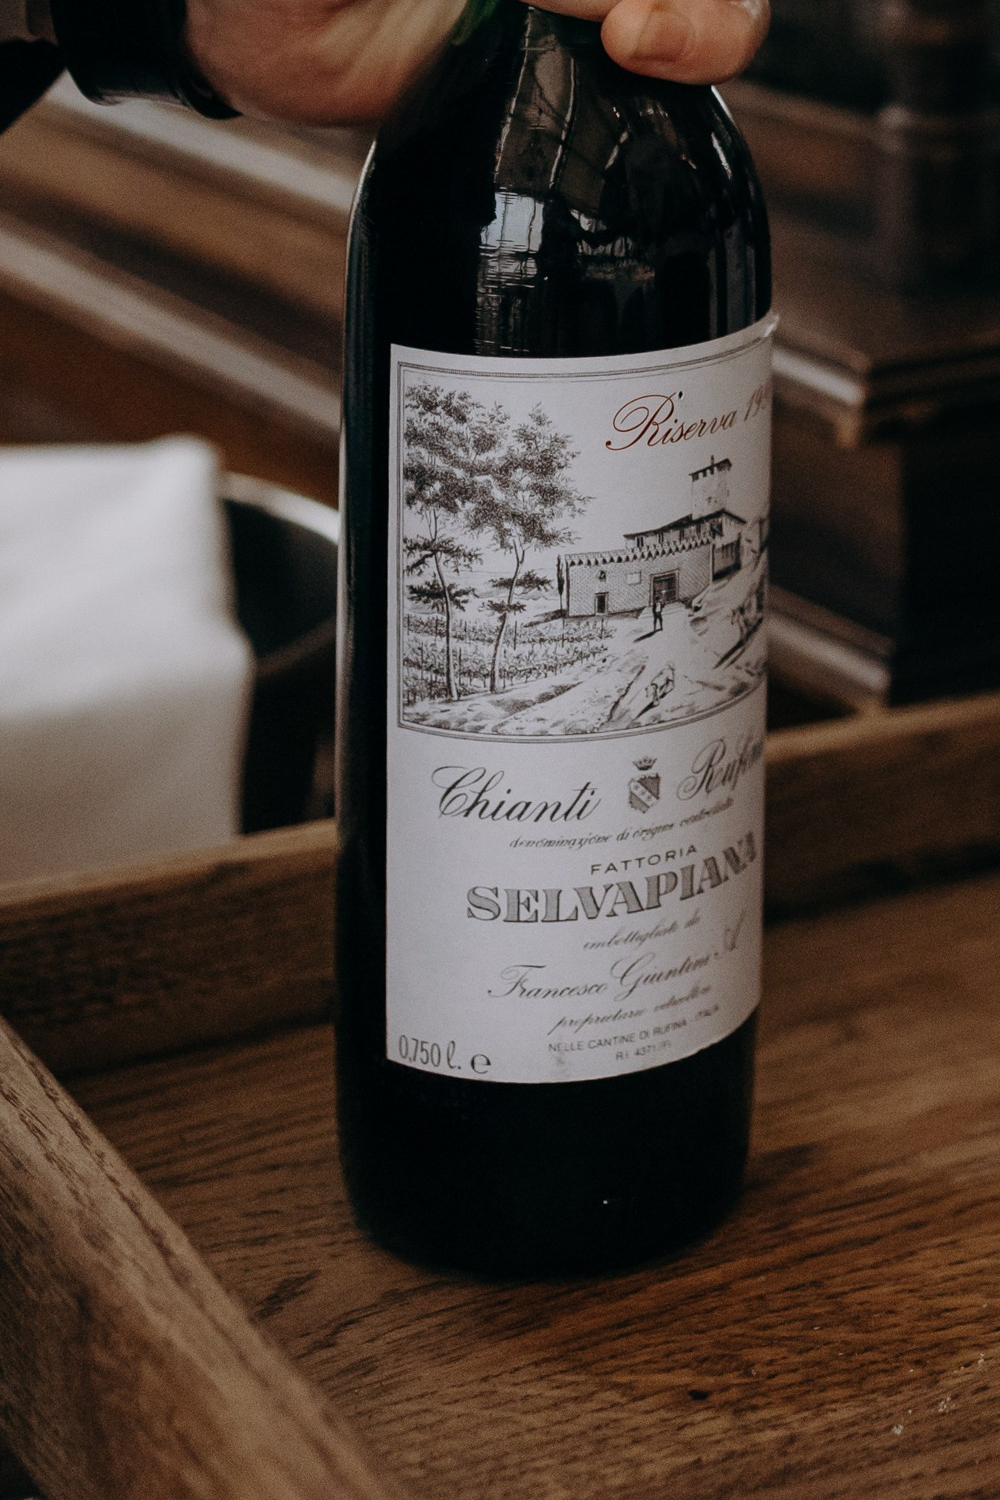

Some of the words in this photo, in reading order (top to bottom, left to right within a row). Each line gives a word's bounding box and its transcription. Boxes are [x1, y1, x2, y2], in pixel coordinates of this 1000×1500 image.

[605, 392, 739, 451] Riserva
[431, 765, 602, 823] Chianti
[509, 832, 610, 850] denominazione
[616, 828, 631, 842] di
[591, 844, 698, 876] FATTORIA
[488, 964, 609, 999] Francesco
[548, 1041, 584, 1053] NELLE
[587, 1033, 636, 1050] CANTINE
[639, 1029, 650, 1041] DI
